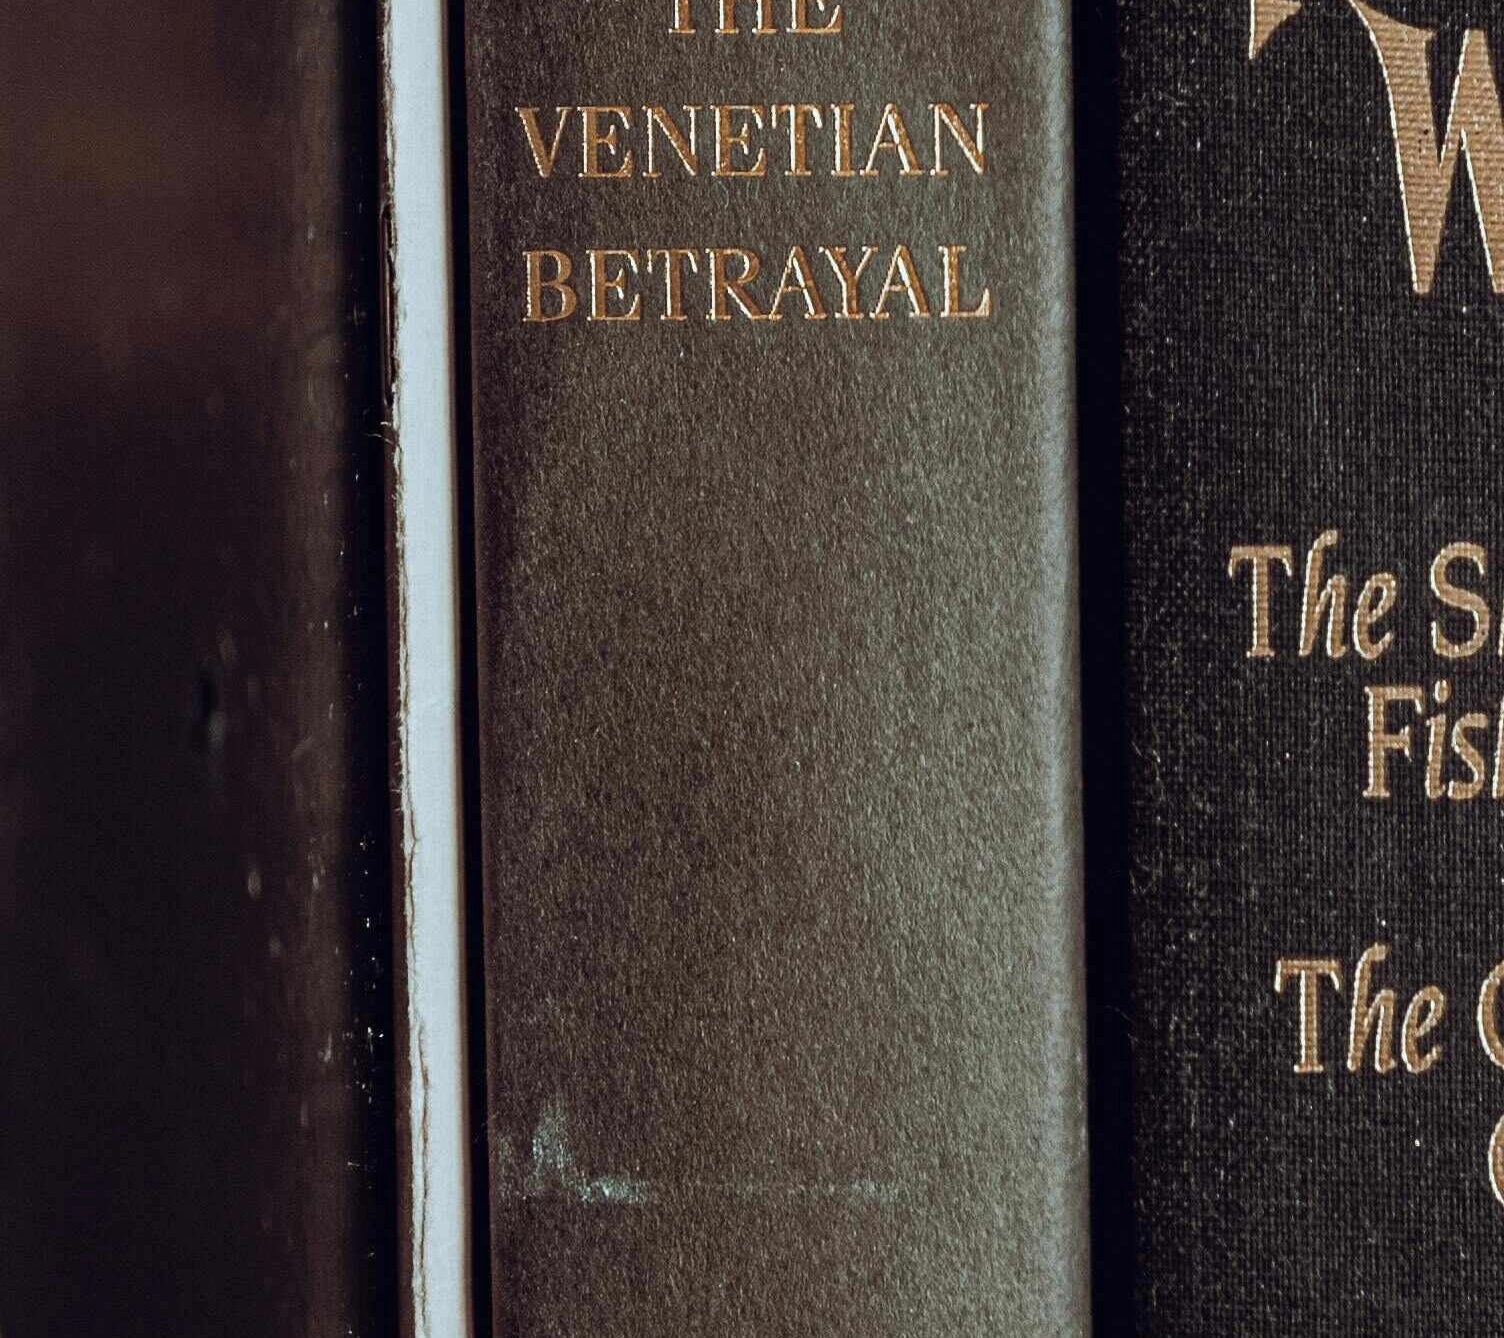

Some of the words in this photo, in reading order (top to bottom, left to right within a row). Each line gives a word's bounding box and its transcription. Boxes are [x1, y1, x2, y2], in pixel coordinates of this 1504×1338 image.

[514, 101, 990, 179] VENETIAN
[521, 244, 992, 323] BETRAYAL
[1227, 528, 1397, 661] The
[1272, 942, 1446, 1075] The
